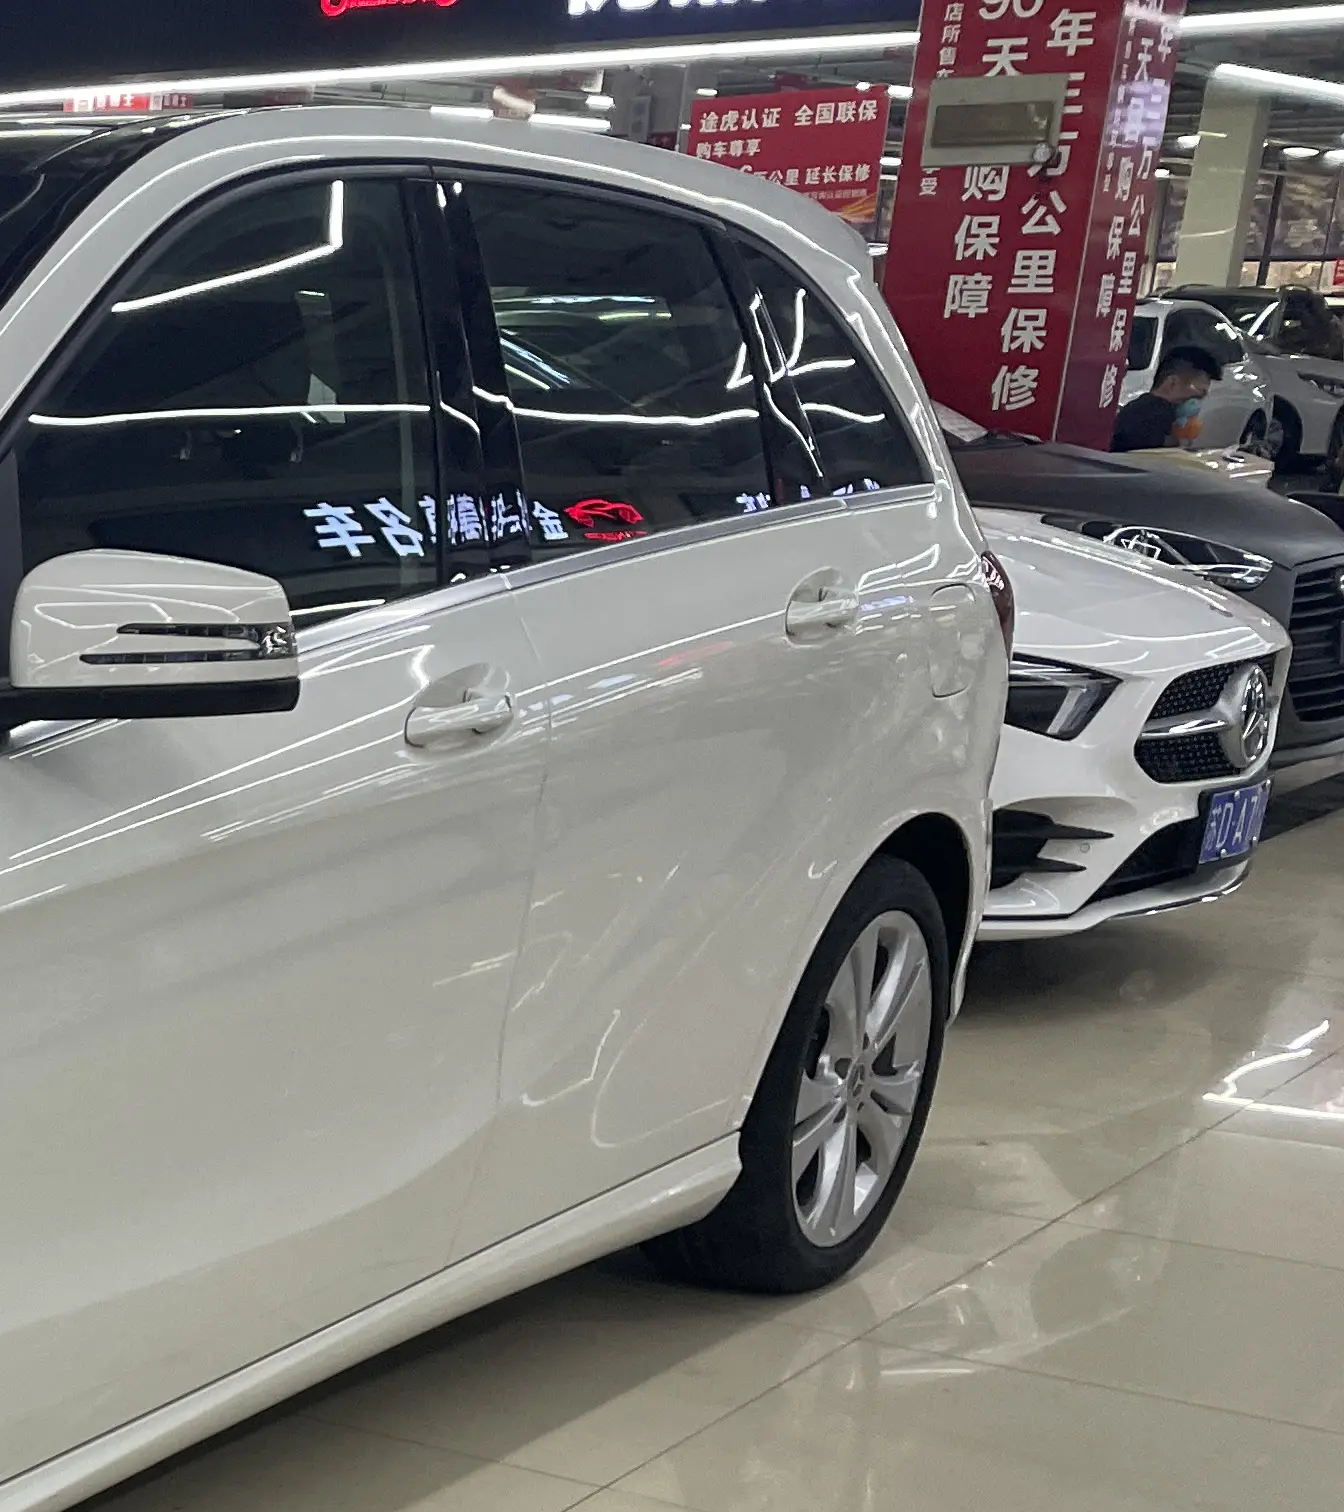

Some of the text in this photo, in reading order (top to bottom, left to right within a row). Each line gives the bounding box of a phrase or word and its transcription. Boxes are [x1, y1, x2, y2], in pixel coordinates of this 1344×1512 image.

[699, 99, 879, 133] 途虎认证 全国联保
[696, 138, 761, 159] 购车尊享
[805, 163, 871, 185] 延长保修
